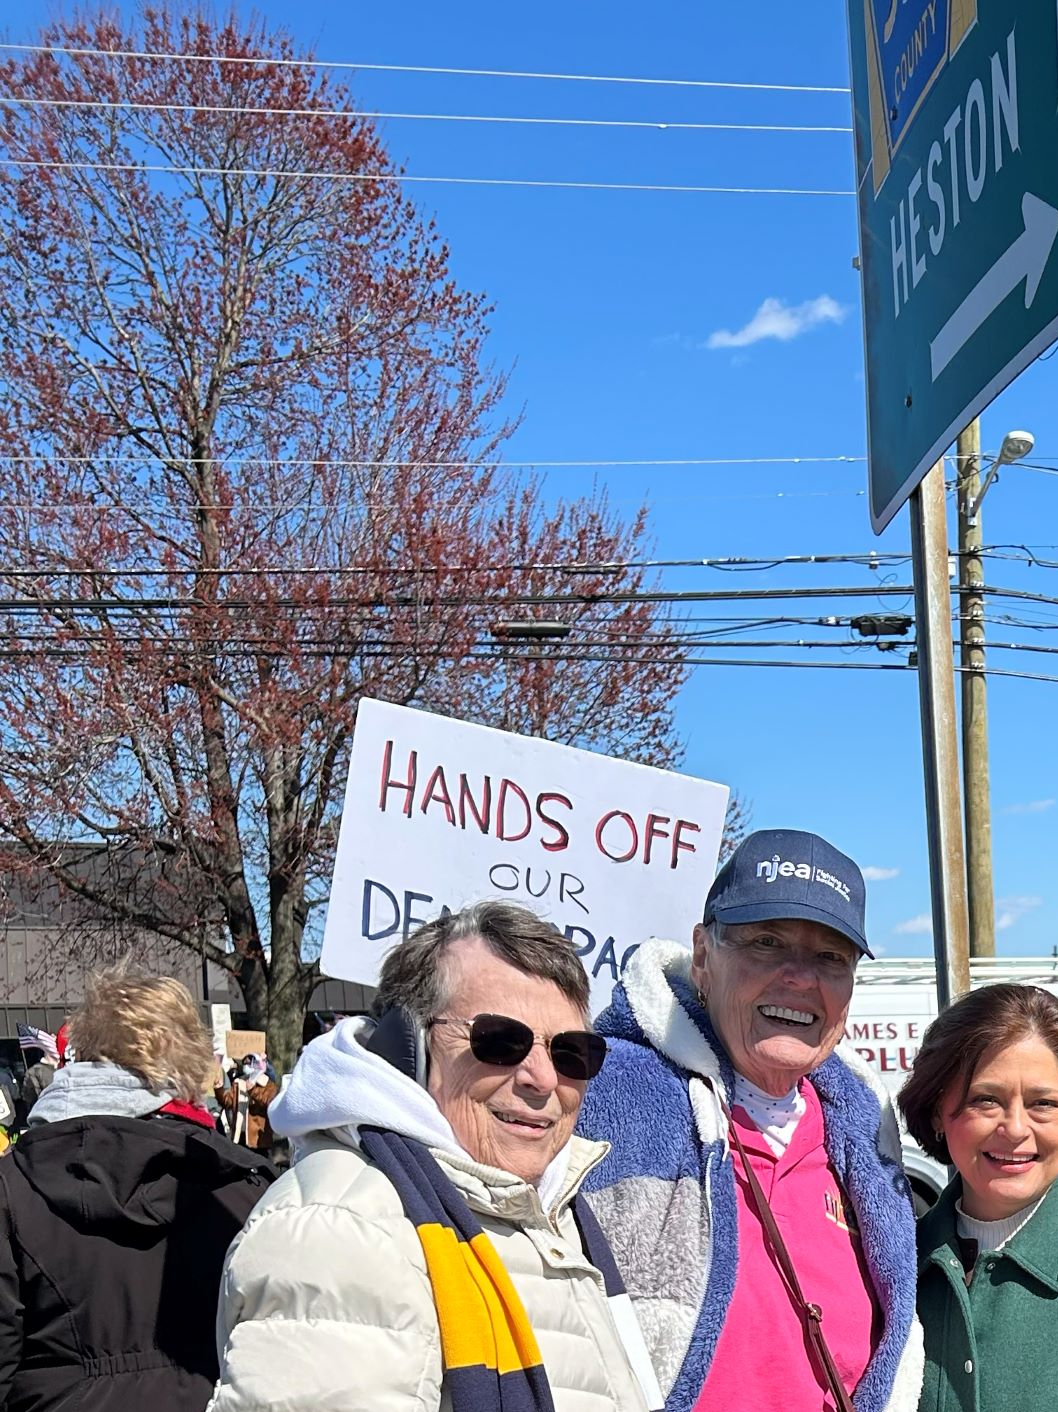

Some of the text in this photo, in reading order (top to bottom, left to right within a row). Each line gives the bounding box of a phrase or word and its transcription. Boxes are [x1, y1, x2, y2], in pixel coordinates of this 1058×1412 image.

[894, 0, 936, 104] COUNTY
[890, 24, 1021, 318] HESTON
[379, 740, 701, 869] HANDS OFF
[489, 864, 589, 913] OUR
[756, 854, 811, 882] njea
